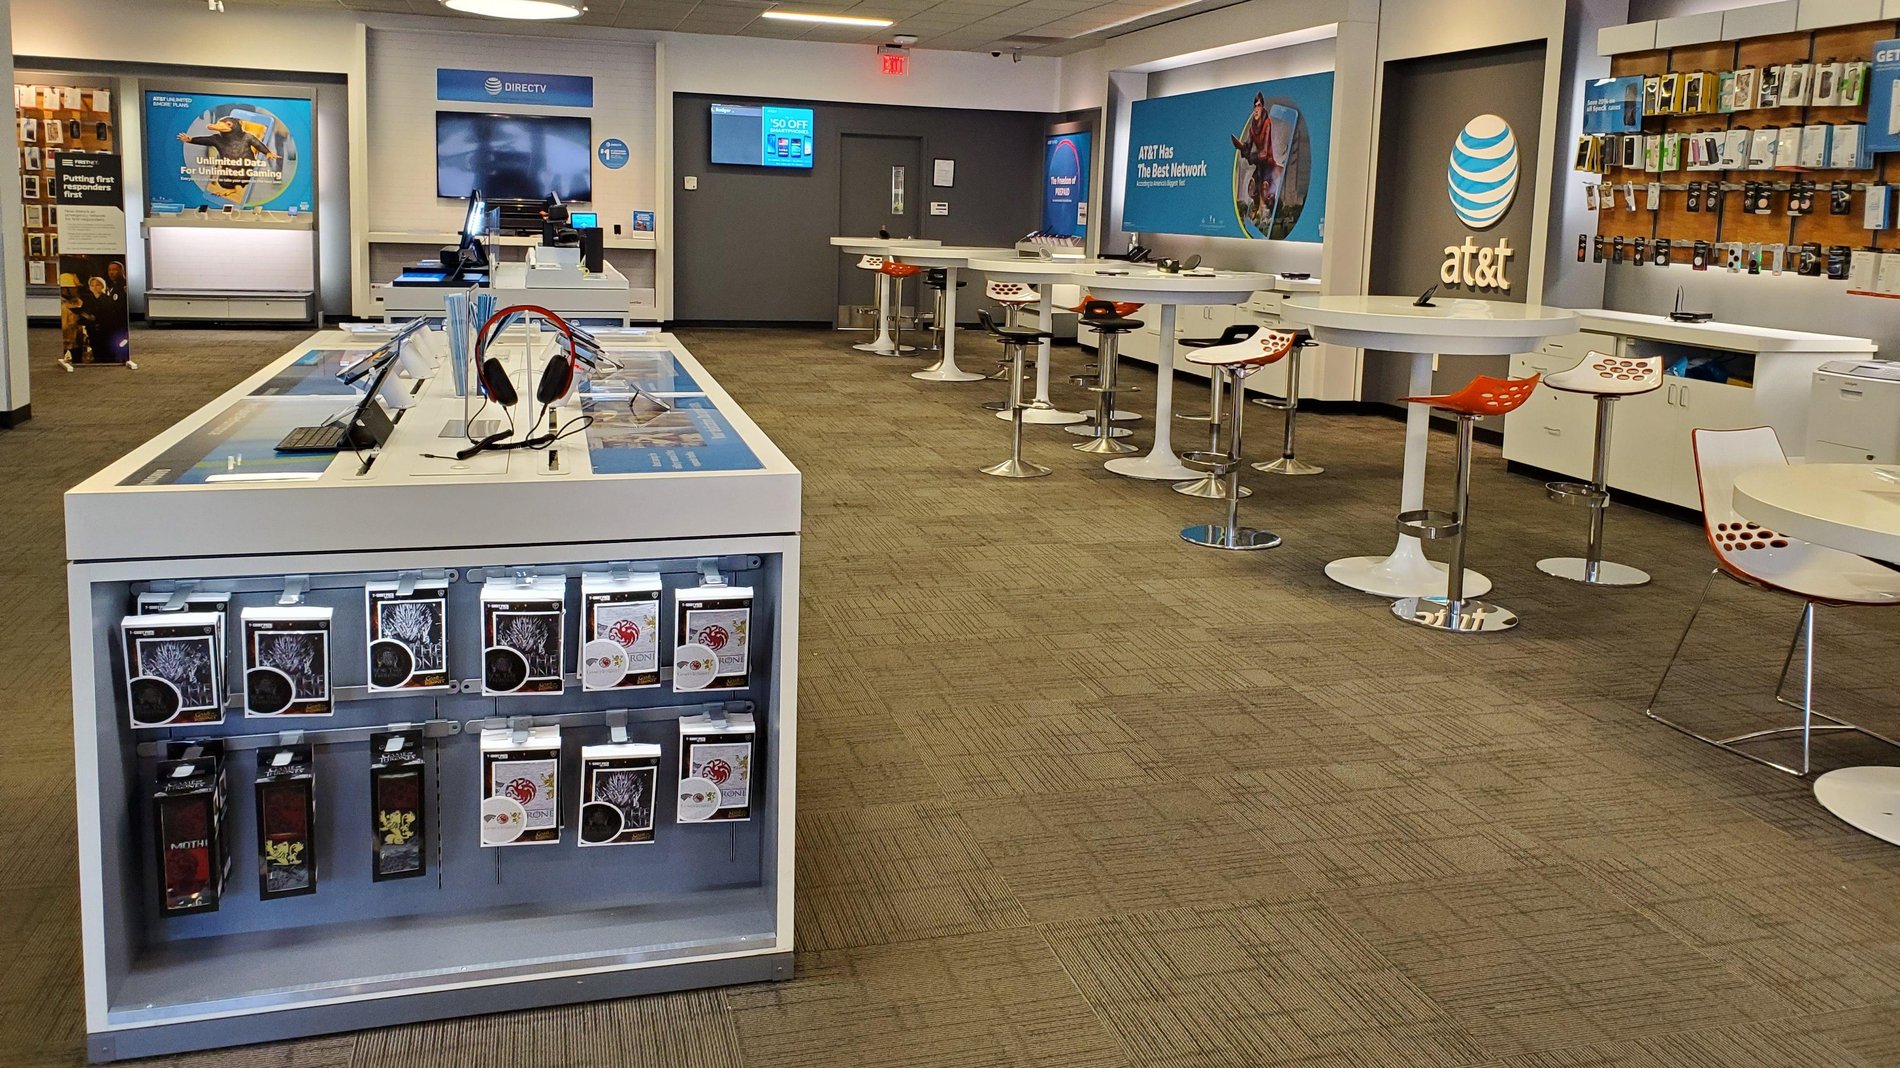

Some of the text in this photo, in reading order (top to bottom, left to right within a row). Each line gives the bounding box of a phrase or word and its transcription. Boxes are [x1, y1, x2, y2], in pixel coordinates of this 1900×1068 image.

[883, 55, 904, 74] EXIT
[504, 82, 547, 93] DIRECTV
[787, 119, 809, 130] OFF
[769, 127, 809, 135] SMARTPHONES
[1138, 144, 1174, 160] AT&T Has
[196, 156, 267, 167] Unlimited Data
[180, 166, 282, 179] For Unlimited Gaming
[1137, 159, 1207, 178] The Best Network
[62, 174, 115, 184] Putting first
[63, 183, 112, 192] responders
[1440, 235, 1514, 291] at&t
